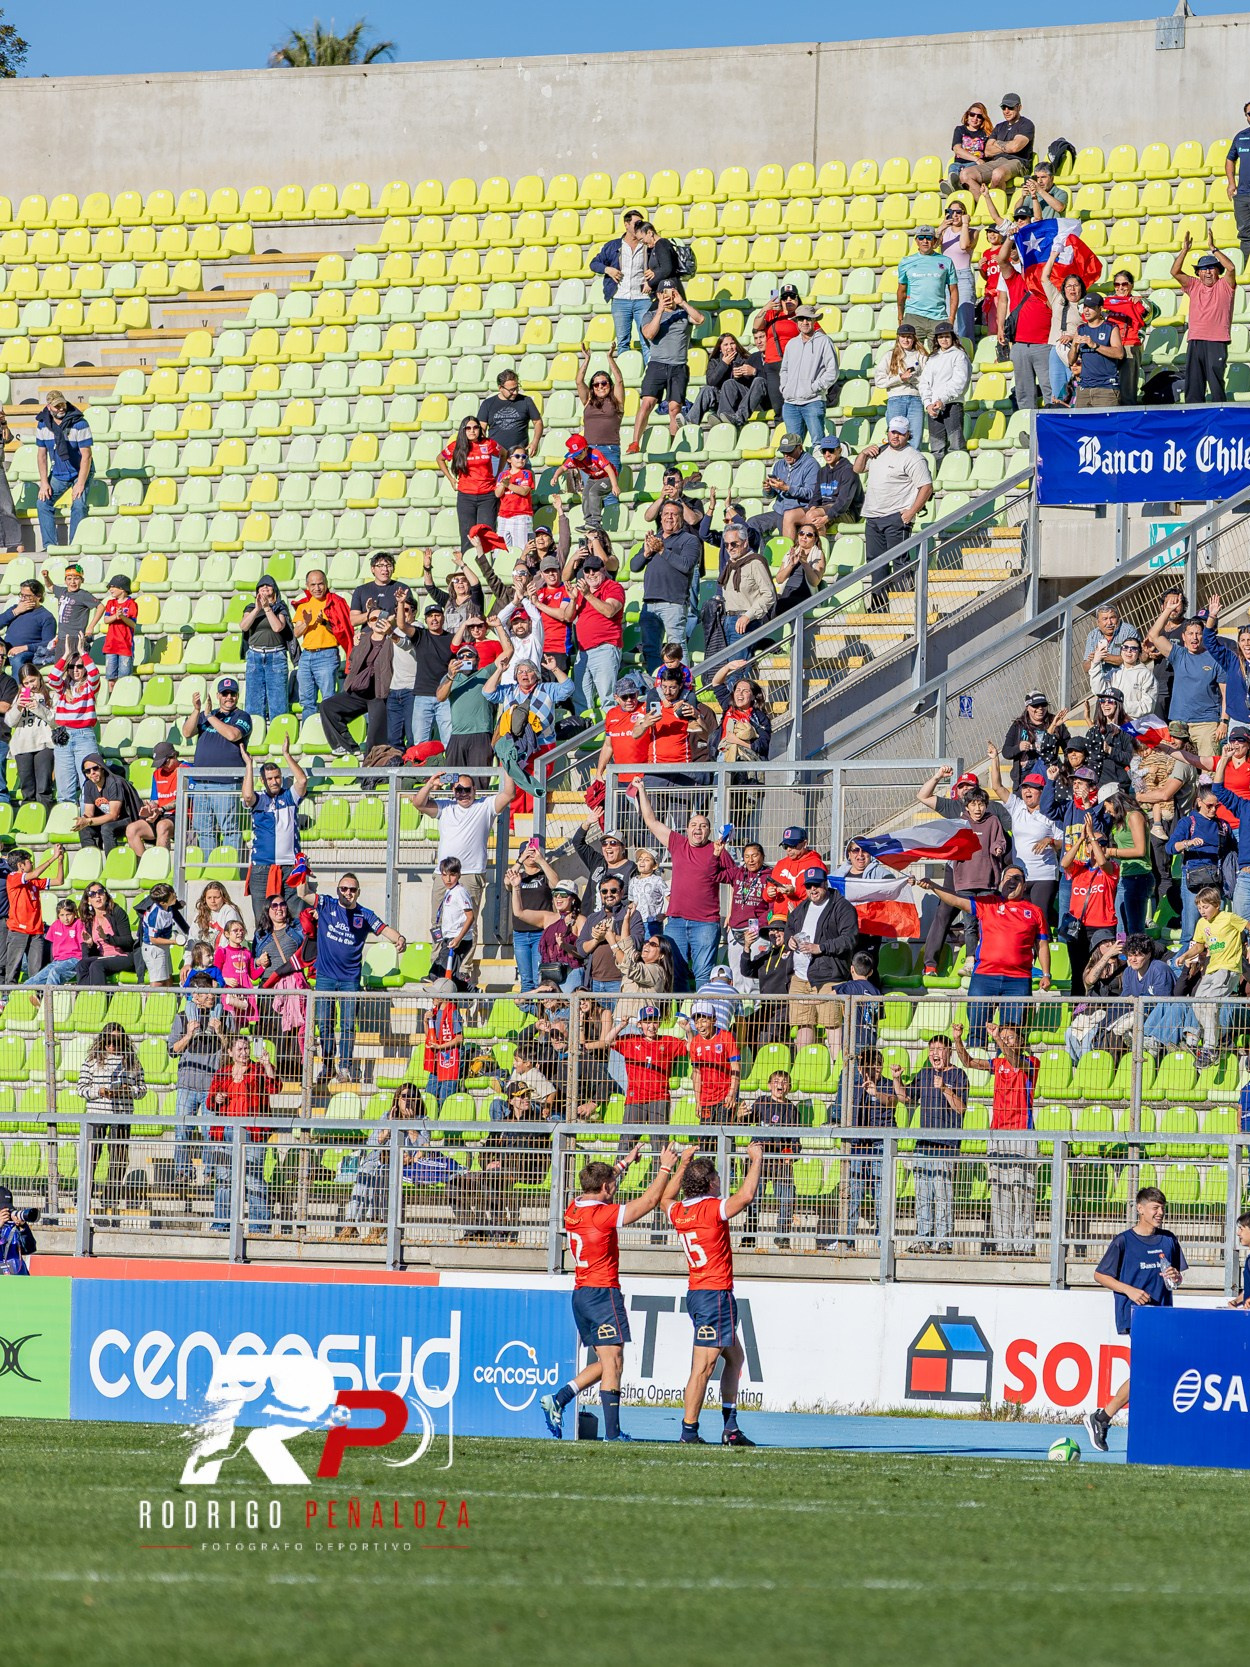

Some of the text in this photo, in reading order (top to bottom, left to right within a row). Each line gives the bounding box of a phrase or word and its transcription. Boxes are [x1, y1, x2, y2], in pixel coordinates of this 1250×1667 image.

[1077, 435, 1153, 475] Banco
[1163, 439, 1187, 473] de
[679, 1231, 709, 1268] 15
[473, 1362, 559, 1386] cencosud
